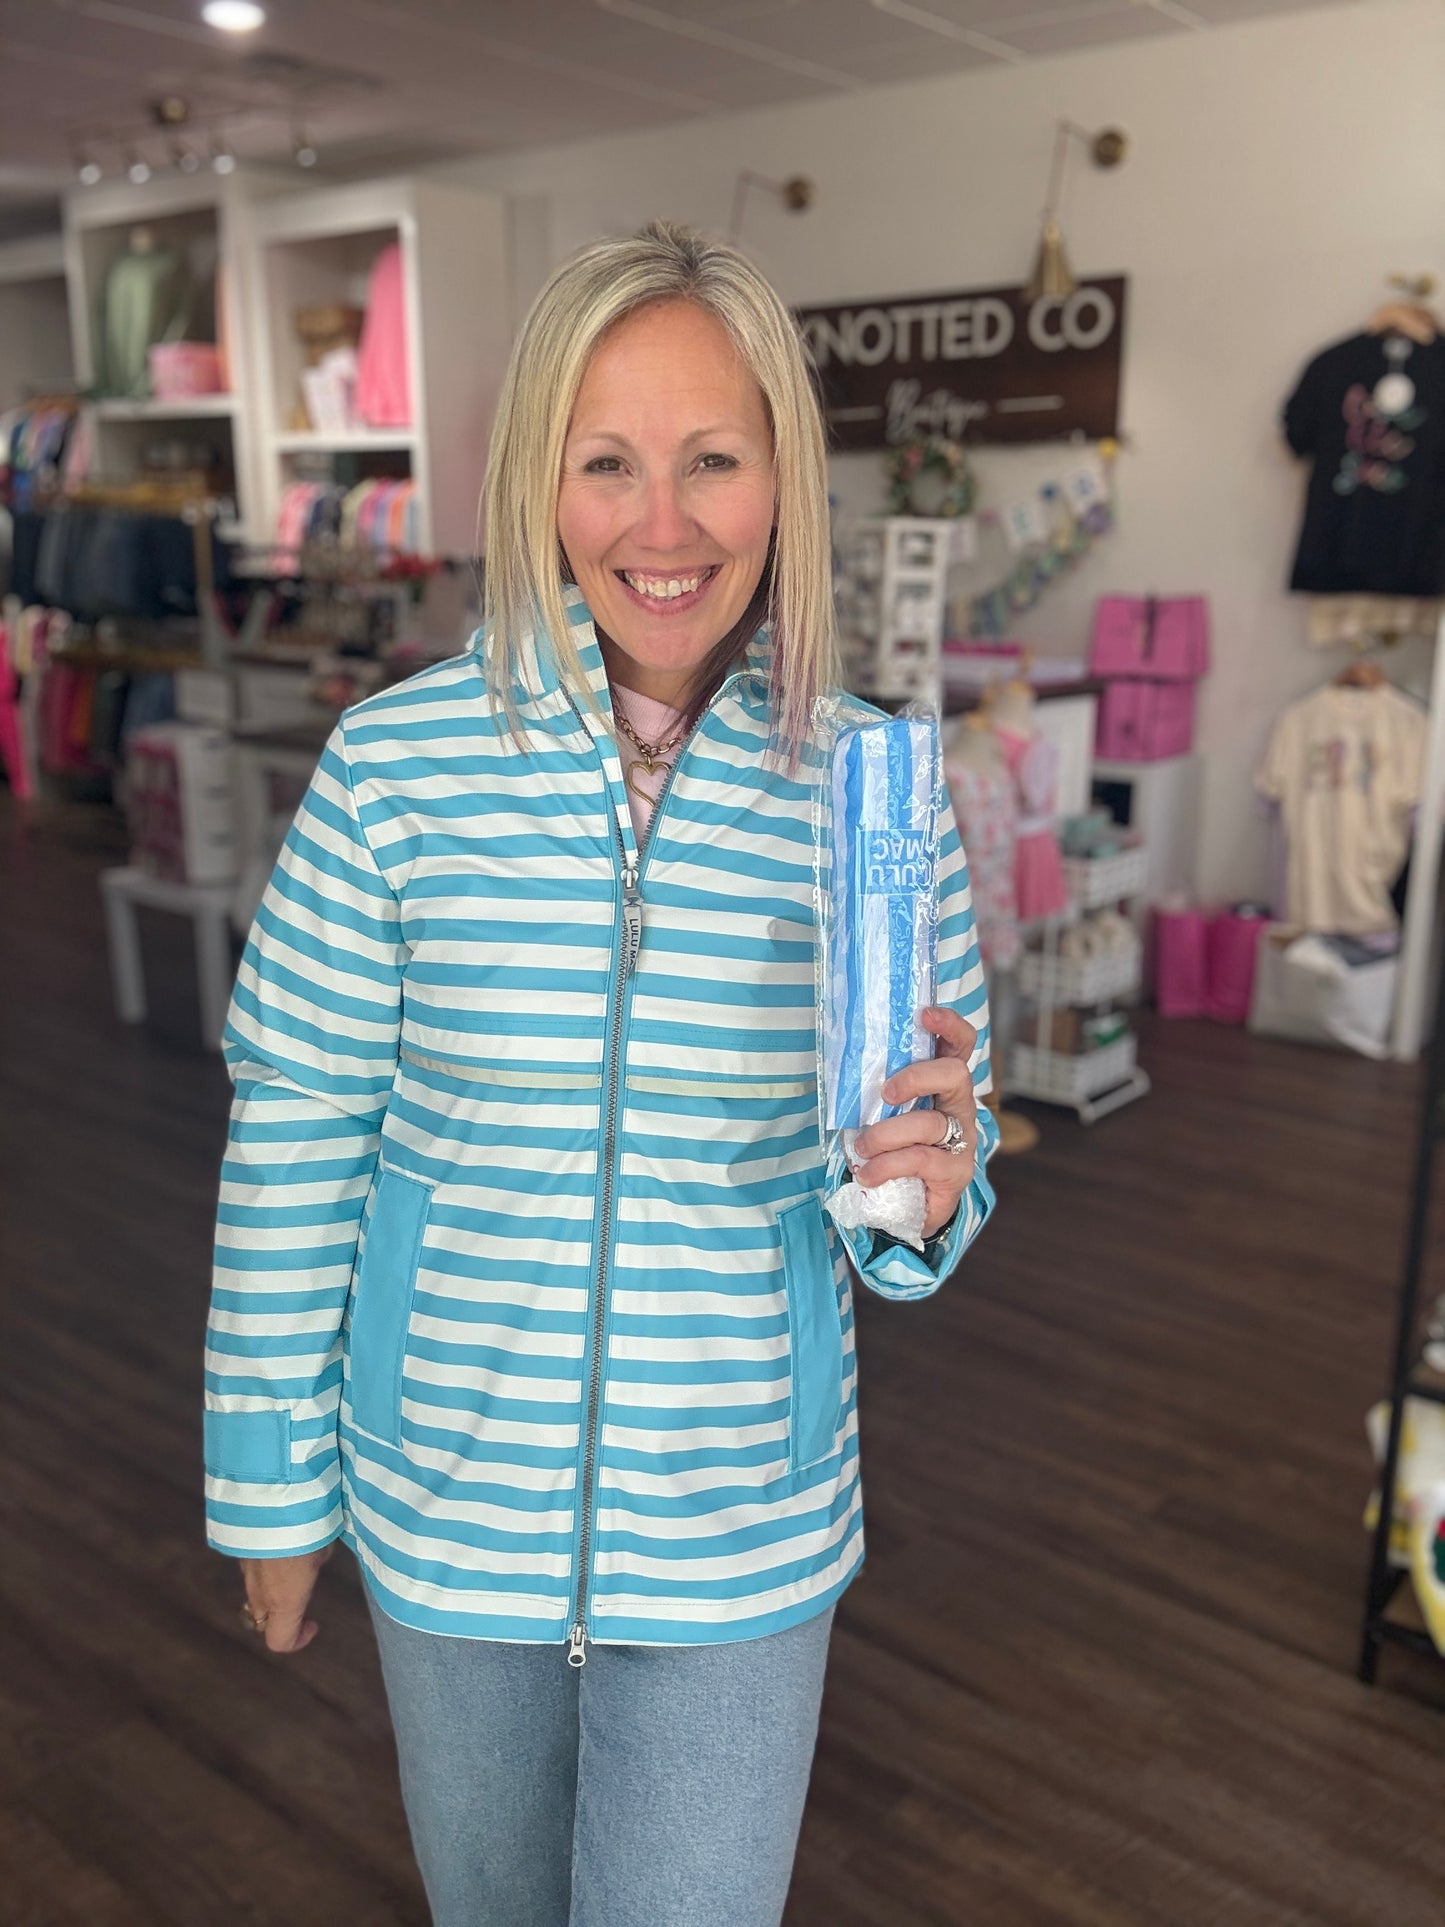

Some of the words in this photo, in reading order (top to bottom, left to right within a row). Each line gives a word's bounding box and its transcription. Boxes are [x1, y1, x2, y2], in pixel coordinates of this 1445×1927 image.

[1027, 286, 1115, 353] CO
[872, 838, 925, 860] MAC
[629, 918, 639, 947] LULU
